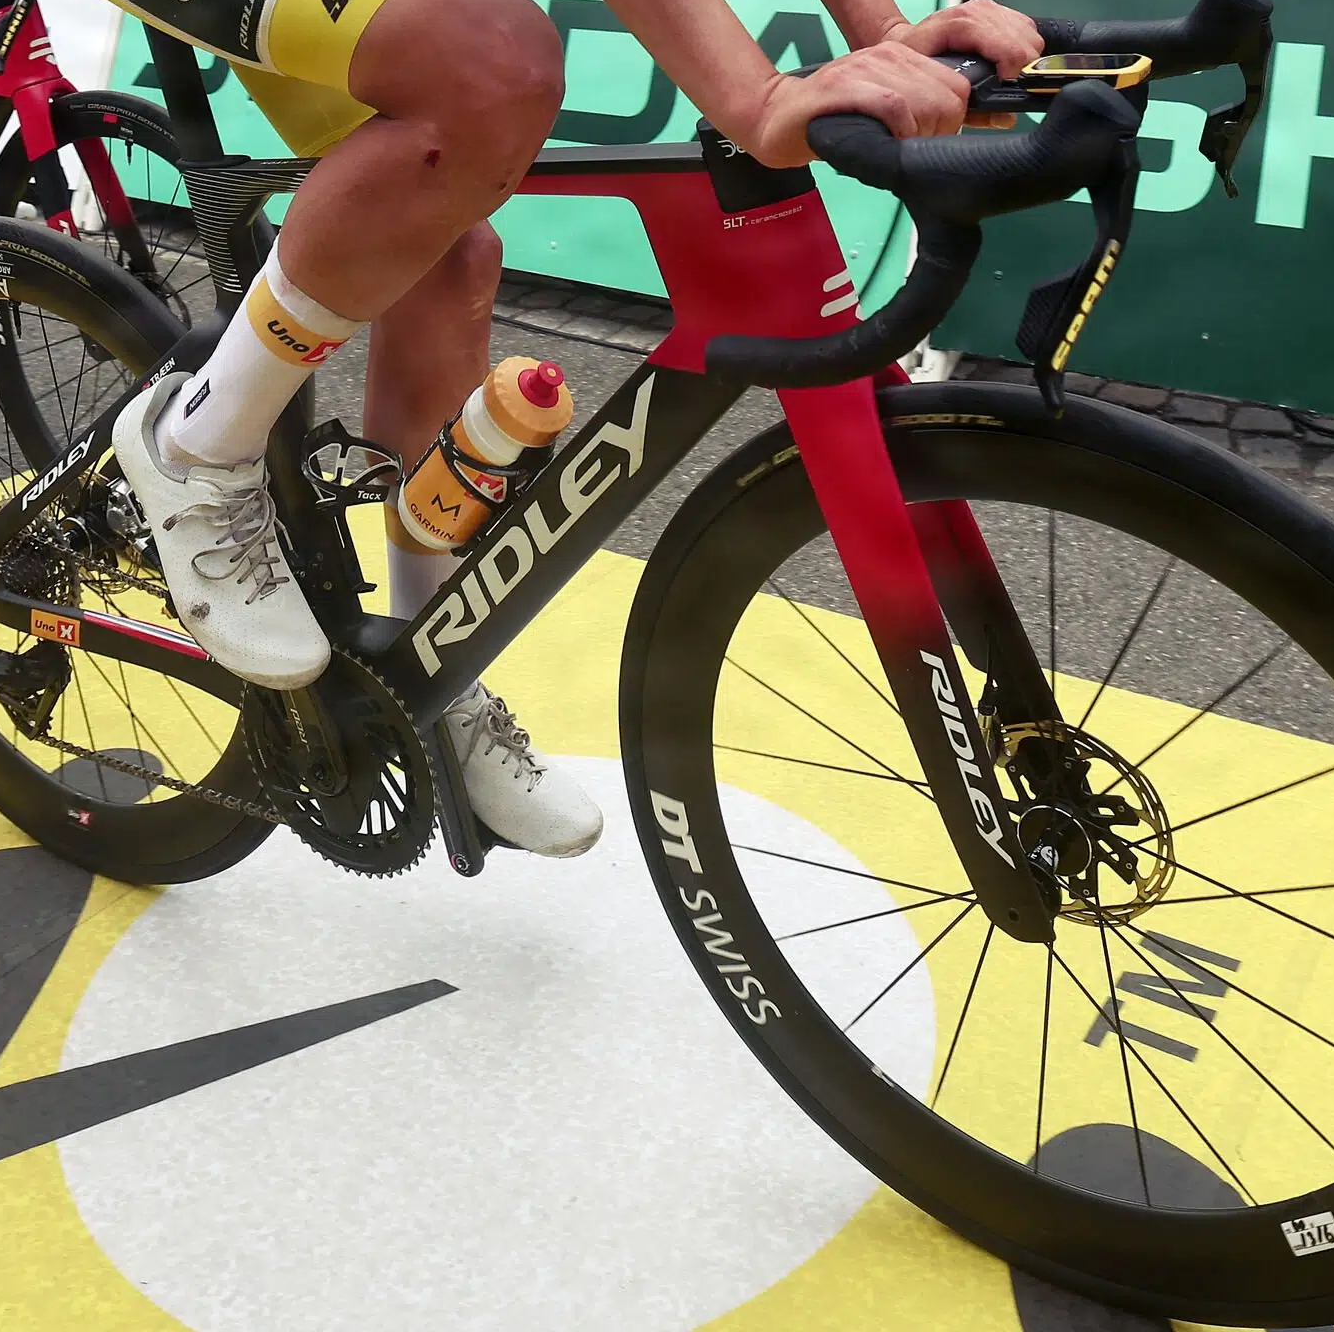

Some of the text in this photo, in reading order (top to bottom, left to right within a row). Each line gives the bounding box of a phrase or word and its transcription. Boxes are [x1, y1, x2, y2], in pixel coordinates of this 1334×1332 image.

[723, 215, 746, 230] SLT
[0, 239, 30, 255] PRIX
[29, 250, 67, 271] 5000
[267, 319, 311, 354] Uno
[149, 357, 176, 385] TRÆEN
[21, 429, 97, 512] RIDLEY
[357, 490, 382, 501] Tacx
[410, 502, 456, 541] GARMIN
[410, 370, 657, 679] RIDLEY
[34, 619, 56, 634] Uno
[919, 648, 1017, 871] RIDLEY
[649, 788, 783, 1027] DT SWISS
[1084, 929, 1242, 1063] TM
